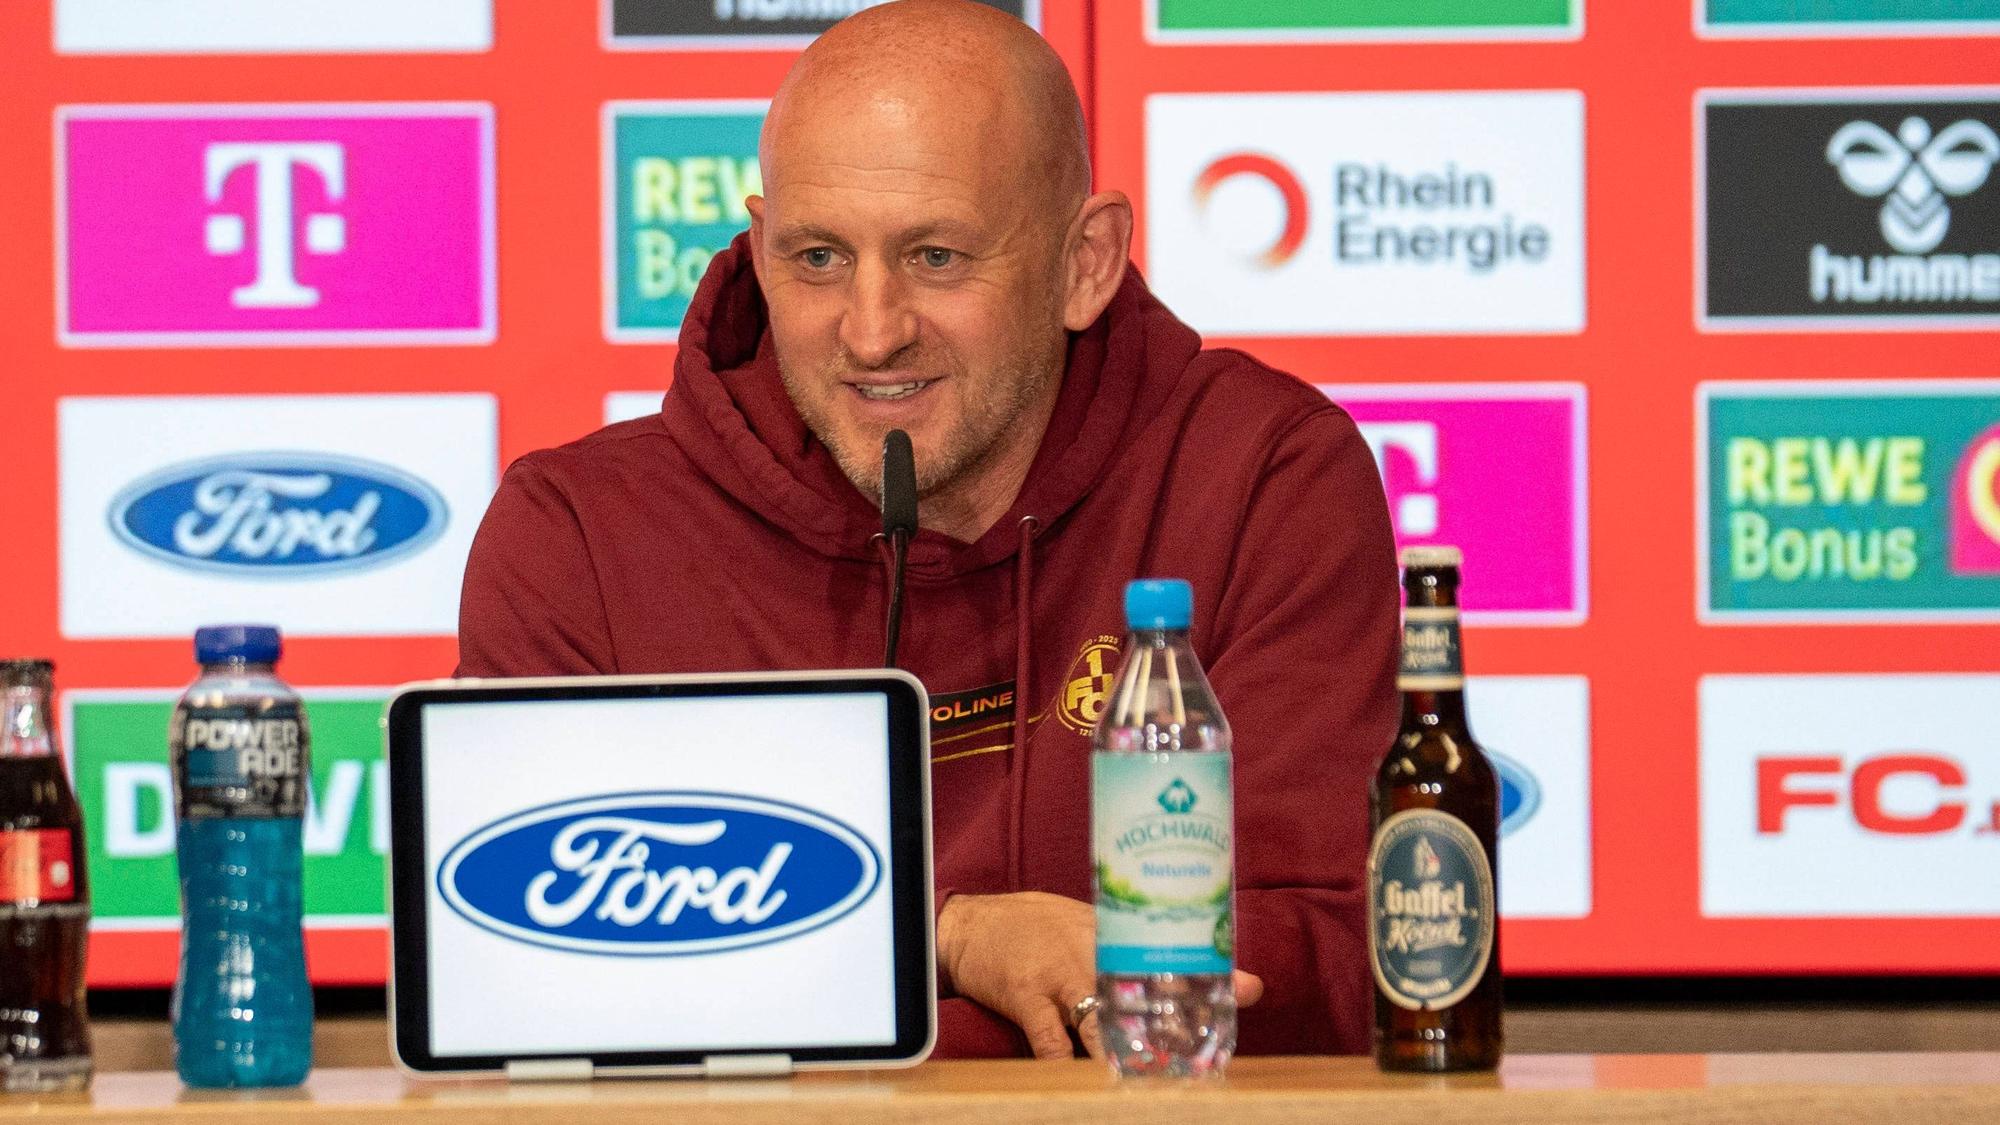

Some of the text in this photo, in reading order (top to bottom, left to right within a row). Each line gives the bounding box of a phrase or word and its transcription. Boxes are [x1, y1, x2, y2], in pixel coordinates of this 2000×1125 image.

[1336, 162, 1494, 208] Rhein
[206, 142, 345, 308] T
[1337, 213, 1550, 272] Energie
[1727, 436, 1926, 505] REWE
[173, 470, 381, 557] Ford
[1731, 510, 1918, 580] Bonus
[187, 719, 299, 748] POWER
[929, 691, 1014, 722] OLINE
[238, 750, 300, 776] ADE
[524, 816, 793, 927] Ford
